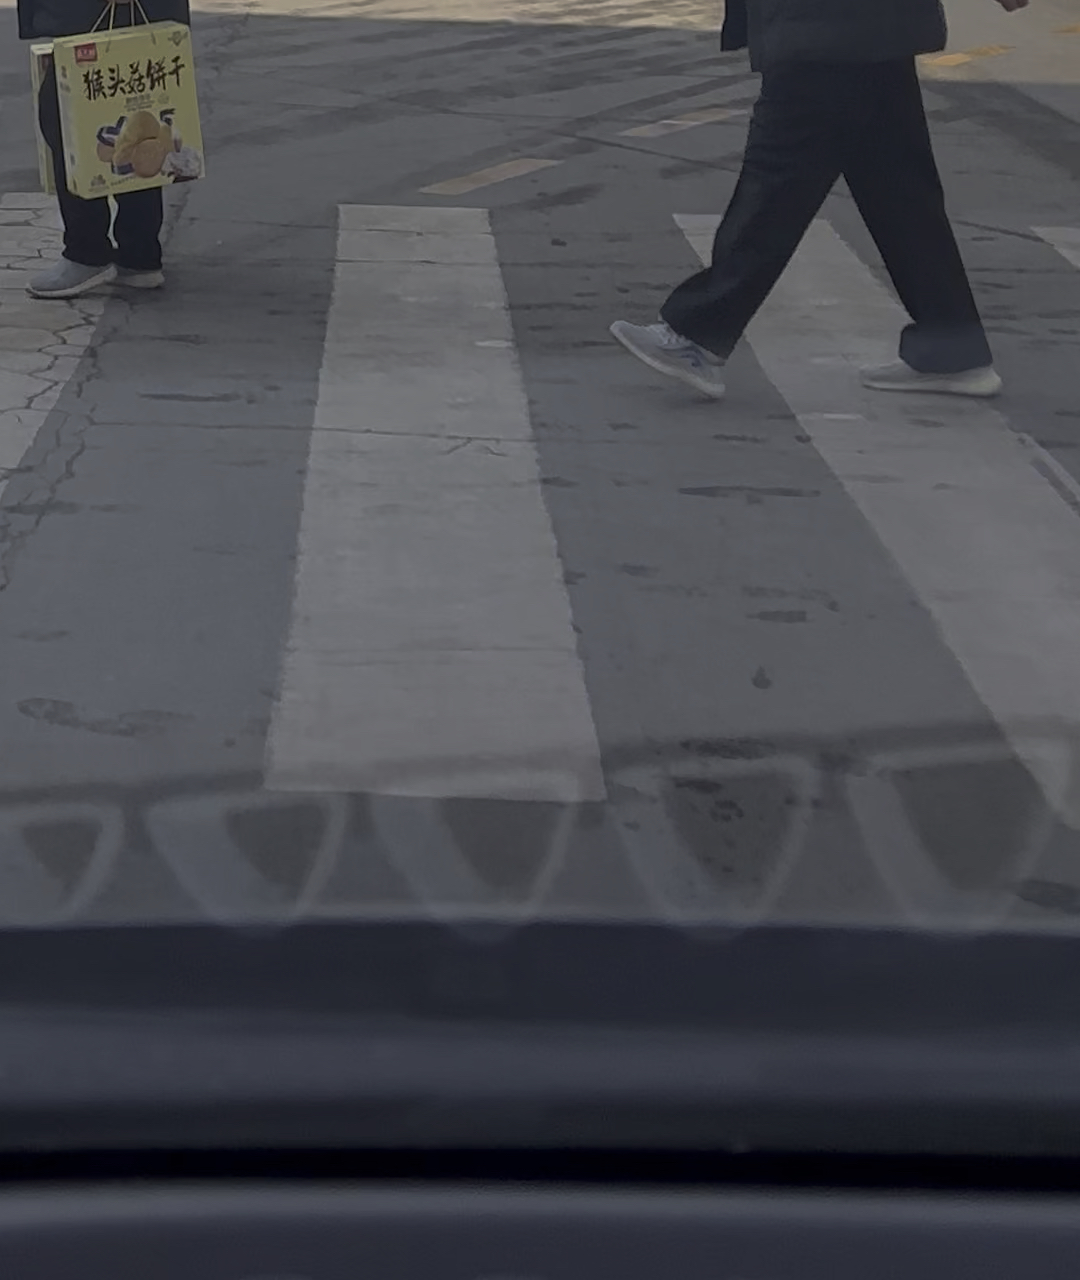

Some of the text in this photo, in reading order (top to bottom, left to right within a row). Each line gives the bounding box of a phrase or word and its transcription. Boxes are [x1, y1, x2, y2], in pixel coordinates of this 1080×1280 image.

[82, 55, 185, 101] 猴头菇饼干
